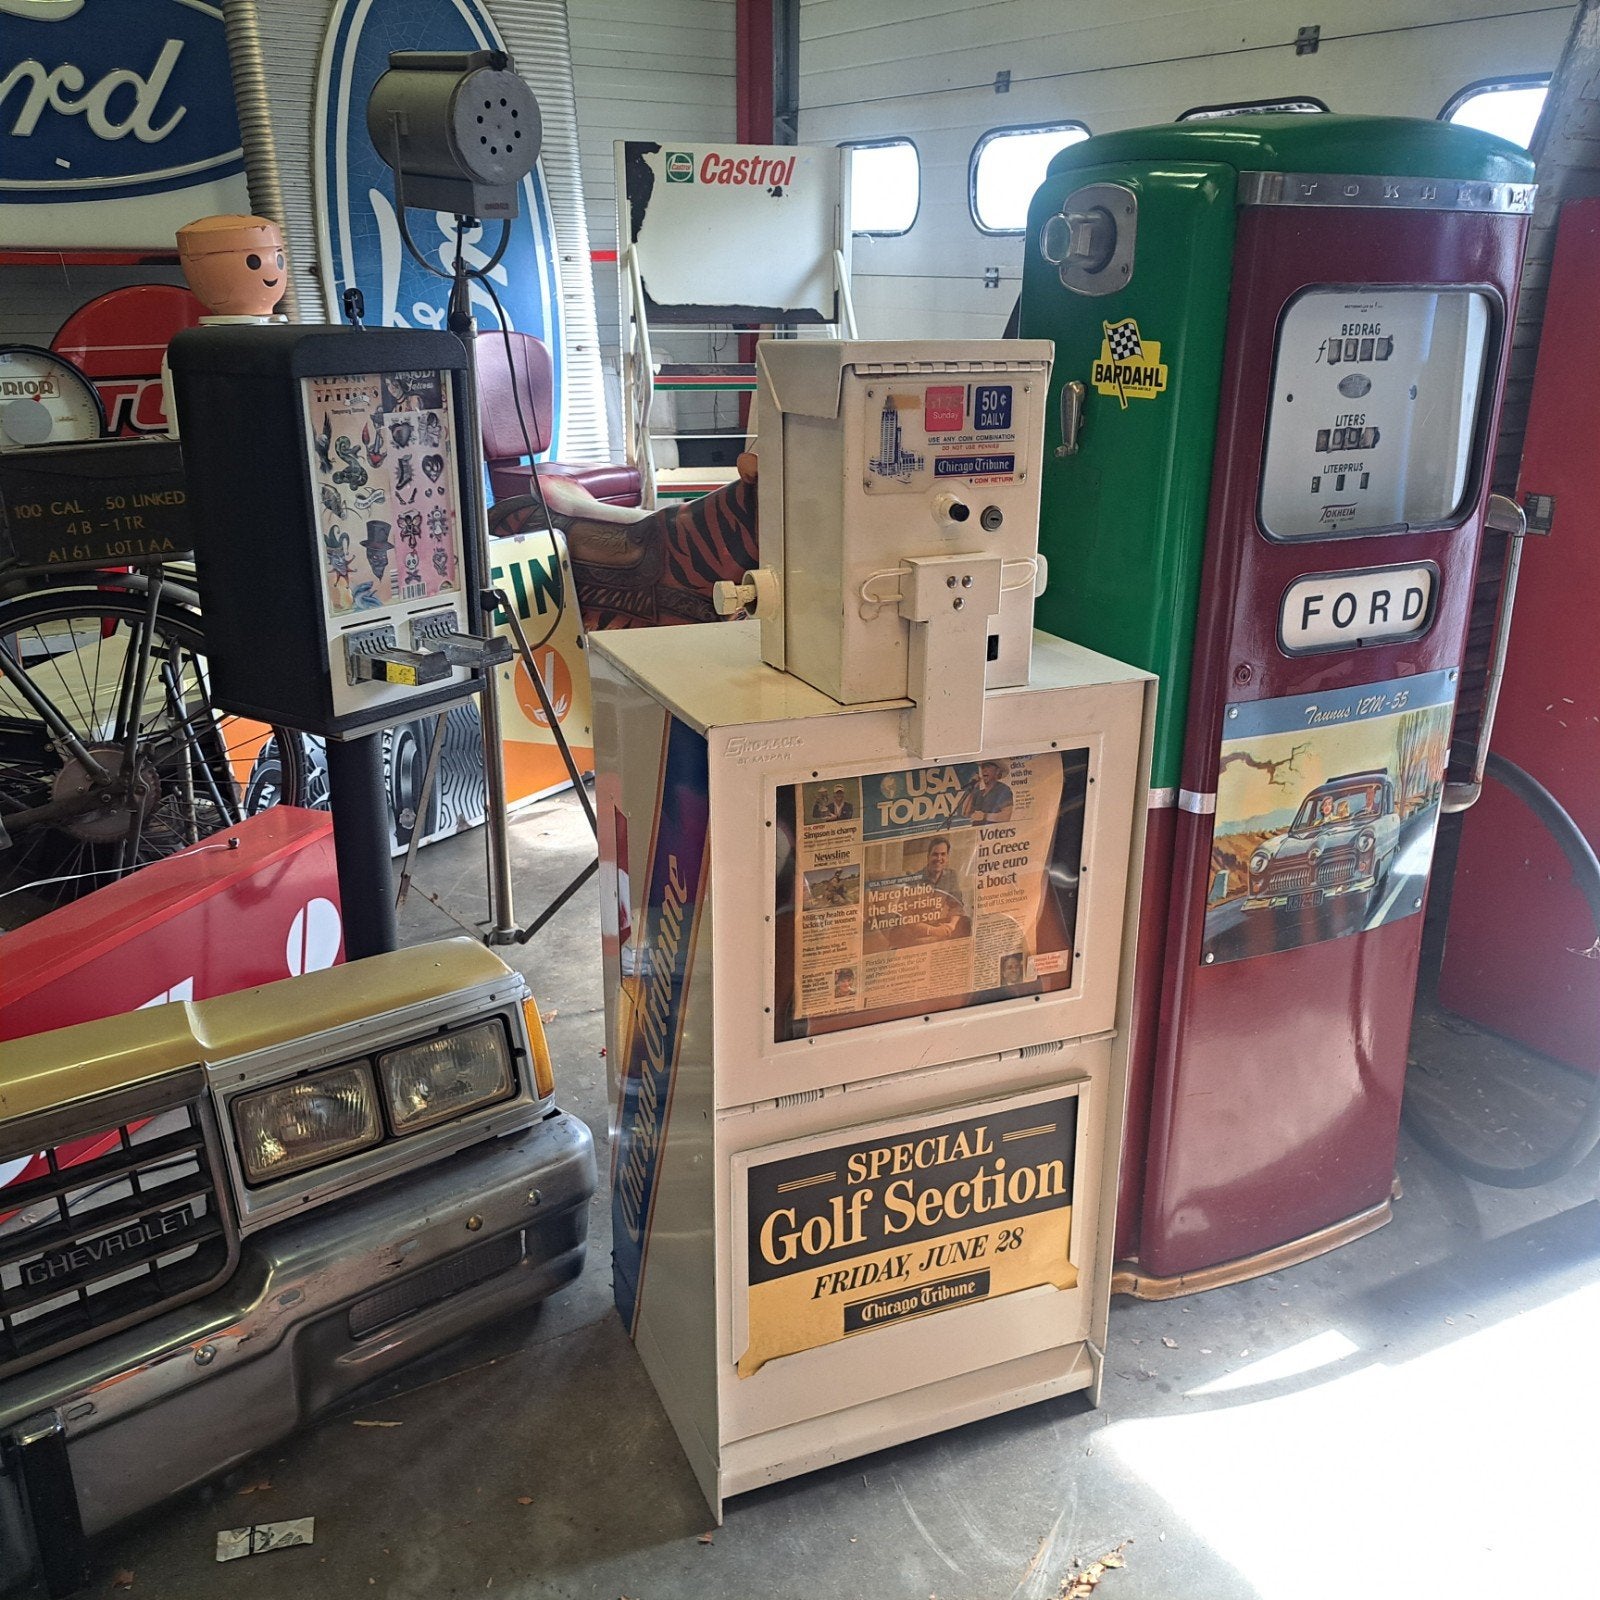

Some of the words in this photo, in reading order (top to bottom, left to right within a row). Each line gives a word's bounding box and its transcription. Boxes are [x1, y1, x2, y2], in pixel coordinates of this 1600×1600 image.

[0, 38, 187, 143] rd
[700, 152, 796, 186] Castrol
[1341, 323, 1381, 336] BEDRAG
[1095, 364, 1163, 388] BARDAHL
[0, 380, 54, 396] RIOR
[933, 411, 958, 420] Sunday
[980, 413, 1005, 426] DAILY
[1335, 414, 1366, 427] LITERS
[975, 433, 1015, 441] COMBINATION
[938, 460, 973, 473] Chicago
[975, 457, 1010, 472] Tribune
[15, 504, 43, 519] 100
[133, 491, 186, 508] LINKED
[1320, 502, 1359, 522] TOKHEIM
[1301, 587, 1423, 631] FORD
[1304, 705, 1351, 725] Taunus
[905, 766, 961, 797] USA
[877, 790, 966, 826] TODAY
[804, 831, 829, 839] Simpson
[979, 827, 1017, 841] Voters
[814, 850, 850, 862] Newsline
[978, 845, 989, 857] in
[992, 841, 1030, 855] Greece
[977, 860, 1000, 876] give
[1002, 856, 1028, 868] euro
[977, 879, 984, 889] a
[986, 873, 1017, 888] boost
[868, 890, 901, 902] Marco
[903, 883, 935, 897] Rubio,
[868, 905, 886, 916] the
[887, 897, 943, 913] fast-rising
[847, 1126, 993, 1185] SPECIAL
[759, 1188, 873, 1266] Golf
[883, 1157, 1066, 1236] Section
[26, 1208, 190, 1286] CHEVROLET
[811, 1253, 913, 1300] FRIDAY,
[918, 1234, 989, 1272] JUNE
[994, 1226, 1025, 1255] 28
[861, 1294, 919, 1323] Chicago
[920, 1280, 977, 1306] Tribune
